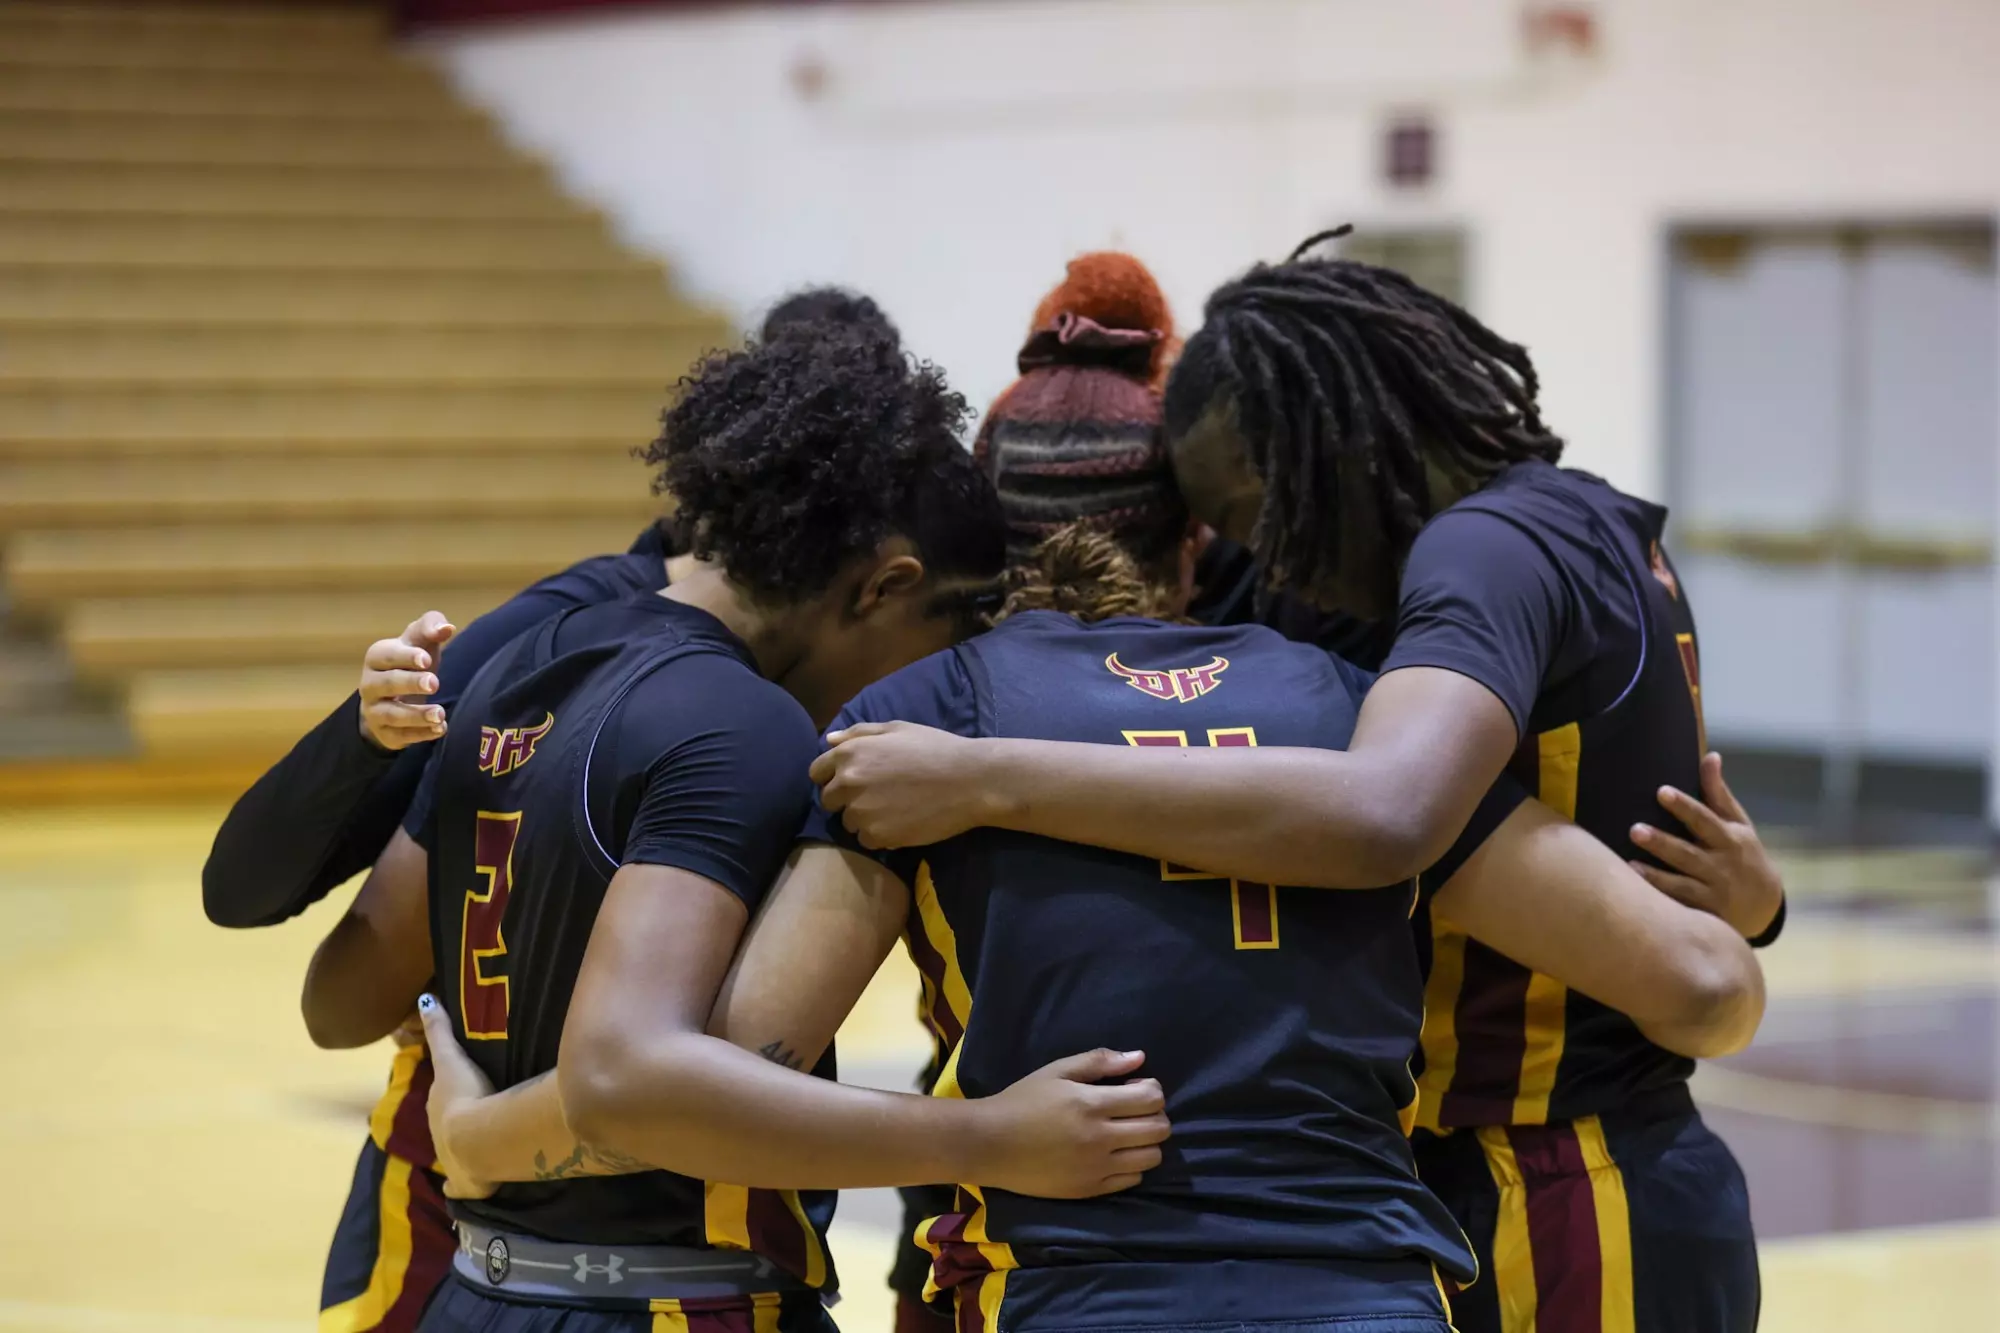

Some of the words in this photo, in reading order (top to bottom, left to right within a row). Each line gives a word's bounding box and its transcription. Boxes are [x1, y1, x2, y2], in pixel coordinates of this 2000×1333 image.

[1105, 652, 1229, 703] DH
[479, 711, 554, 777] DH
[460, 810, 523, 1040] 2
